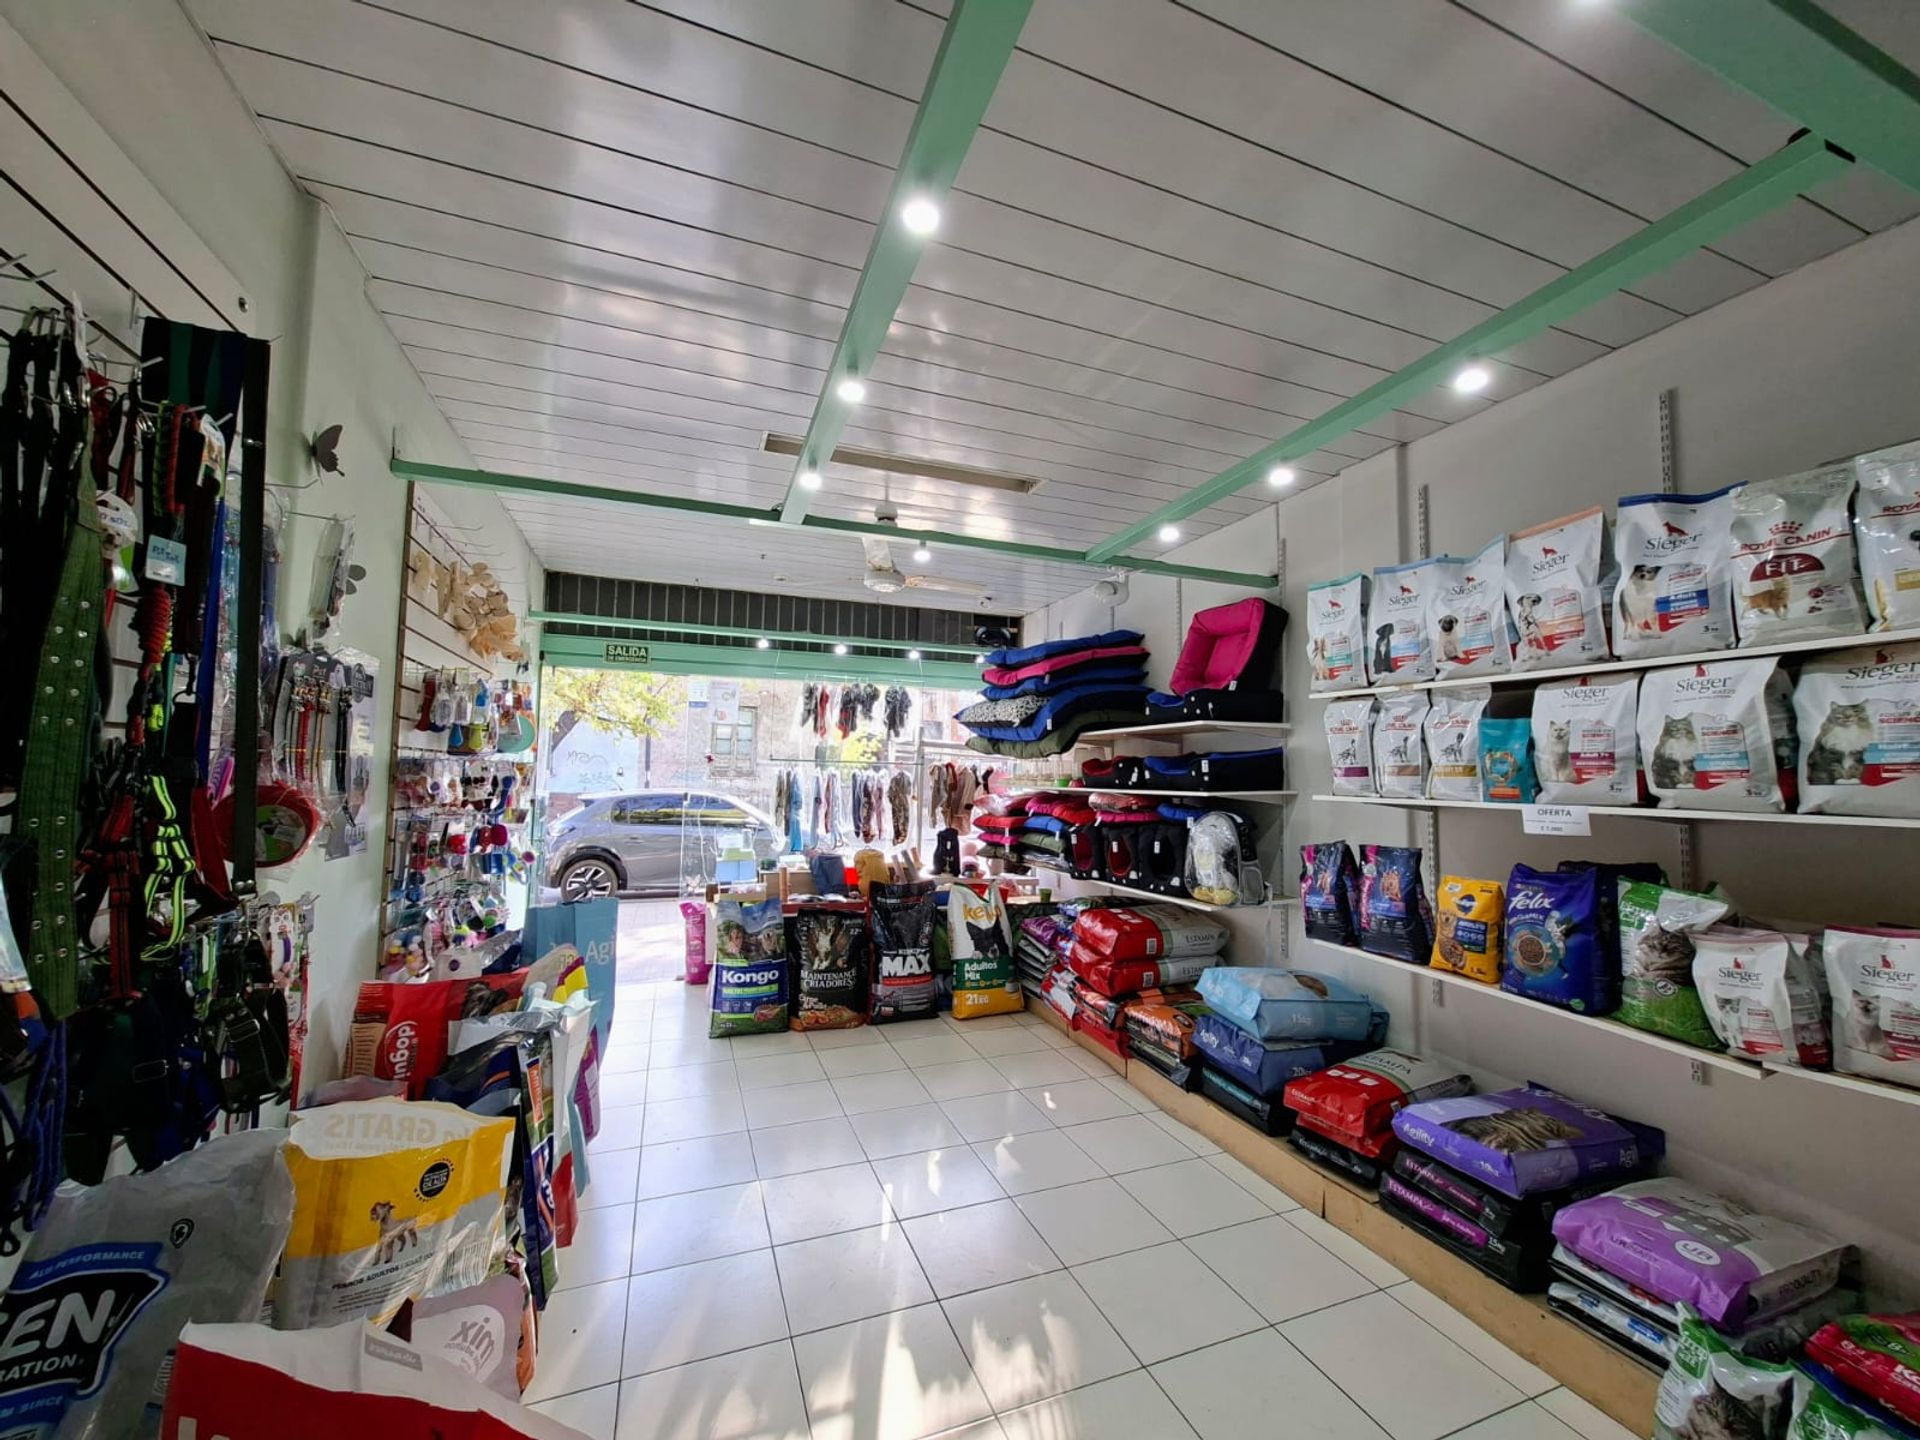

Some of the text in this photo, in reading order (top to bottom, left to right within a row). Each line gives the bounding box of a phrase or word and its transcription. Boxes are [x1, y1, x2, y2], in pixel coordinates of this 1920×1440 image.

[1645, 533, 1704, 552] Sieger
[1740, 528, 1831, 551] ROYAL CANIN
[1532, 553, 1570, 574] Sieger
[1765, 560, 1806, 576] FIT
[607, 644, 648, 657] SALIDA
[1675, 676, 1733, 694] Sieger
[1562, 687, 1609, 702] Sieger
[1537, 808, 1572, 817] OFERTA
[881, 953, 932, 978] MAX
[963, 961, 998, 972] Adultos
[1860, 964, 1916, 983] Sieger
[721, 969, 780, 985] Kongo
[964, 972, 982, 982] Mix
[1718, 966, 1764, 984] Sieger
[1402, 1121, 1435, 1147] Agility
[55, 1250, 145, 1269] PERFORMANCE
